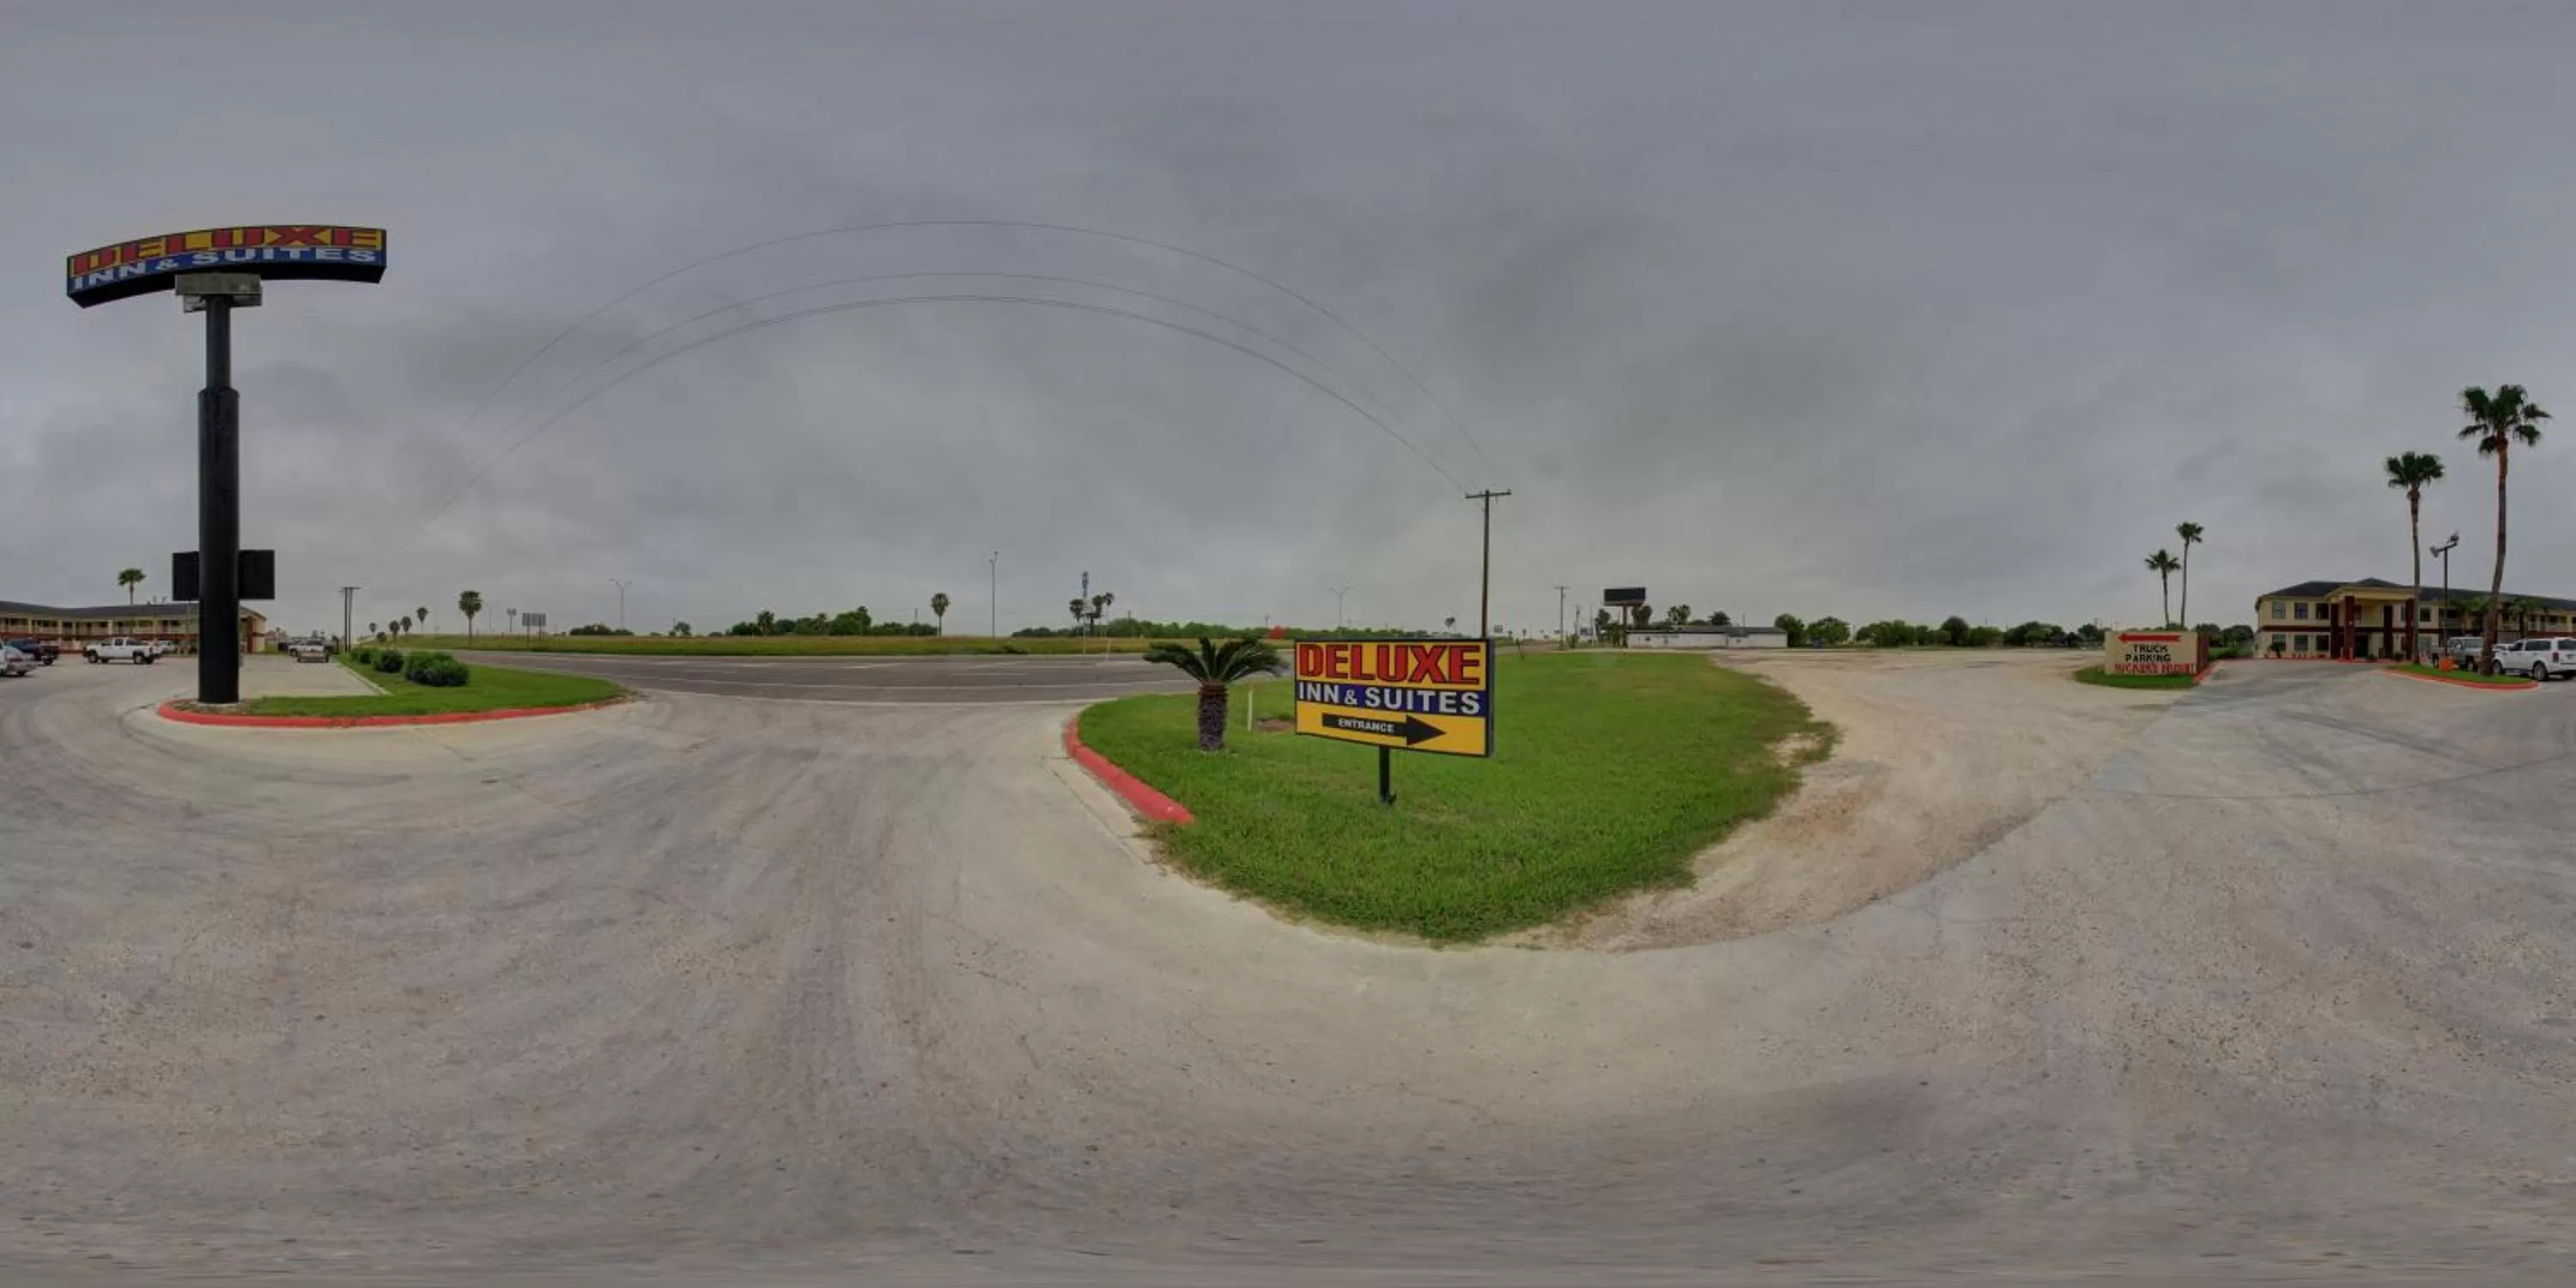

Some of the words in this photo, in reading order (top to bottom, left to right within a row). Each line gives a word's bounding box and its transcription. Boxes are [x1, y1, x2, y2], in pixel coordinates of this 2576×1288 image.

[74, 226, 377, 276] DELUXE
[75, 260, 145, 289] INN
[155, 258, 179, 271] &
[192, 247, 375, 264] SUITES
[1299, 644, 1480, 684] DELUXE
[1299, 682, 1340, 703] INN
[1344, 689, 1358, 705] &
[1365, 687, 1480, 714] SUITES
[1338, 718, 1395, 732] ENTRANCE
